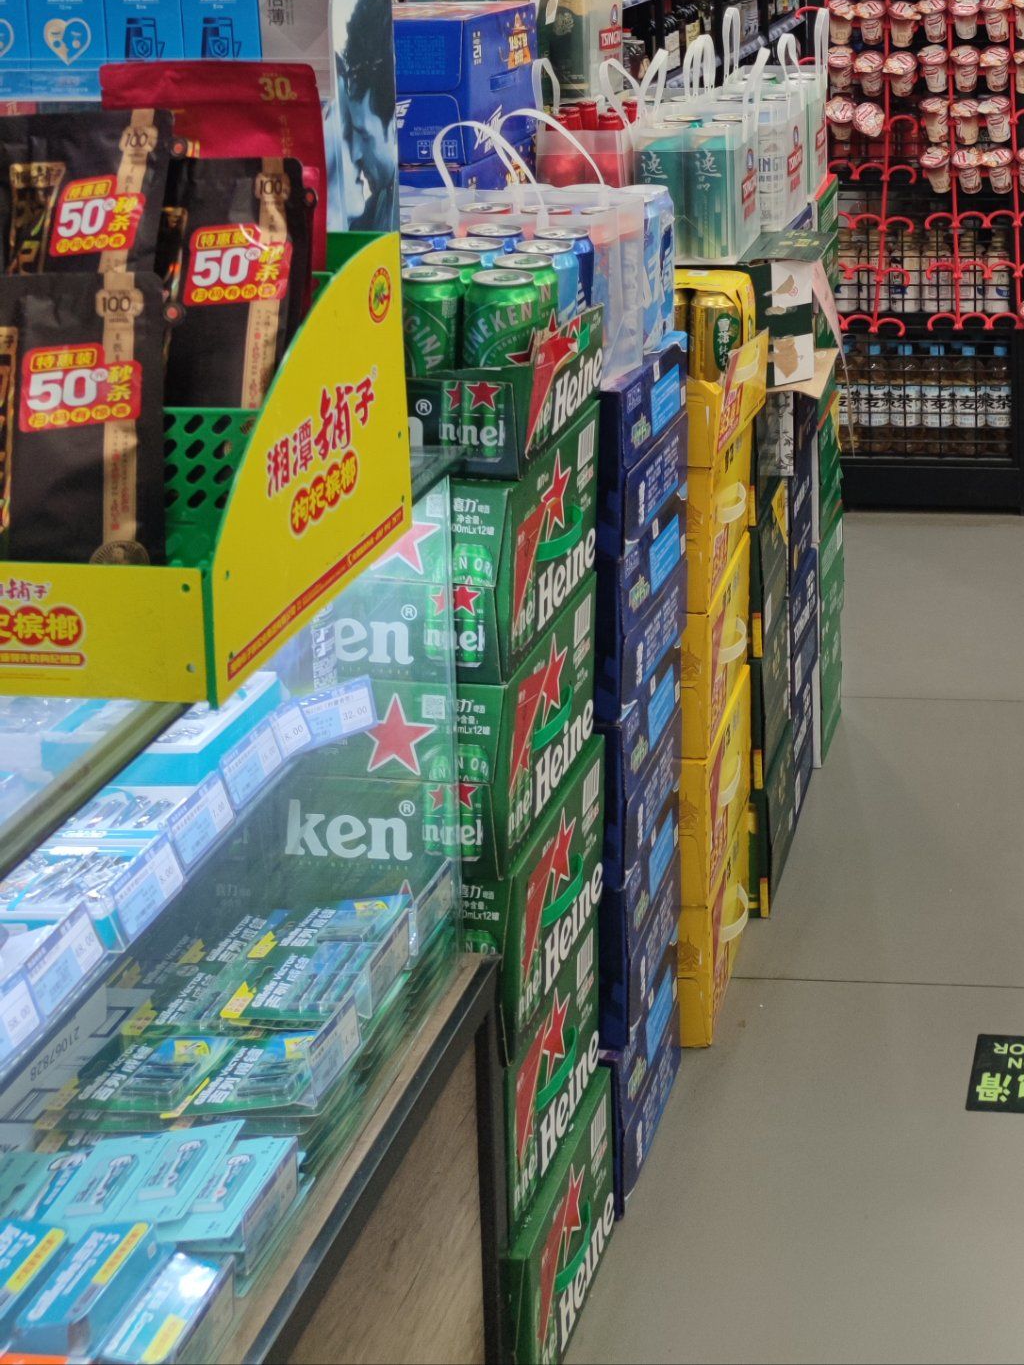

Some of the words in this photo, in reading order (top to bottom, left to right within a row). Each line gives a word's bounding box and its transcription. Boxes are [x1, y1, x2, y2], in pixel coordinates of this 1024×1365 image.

[260, 180, 282, 195] 100
[58, 199, 106, 238] 50
[192, 248, 248, 286] 50
[102, 296, 131, 312] 100
[27, 369, 98, 411] 50
[266, 376, 375, 500] 湘潭铺子
[291, 454, 358, 530] 枸杞槟榔
[451, 525, 495, 536] 00mLx12罐
[285, 798, 413, 862] ken
